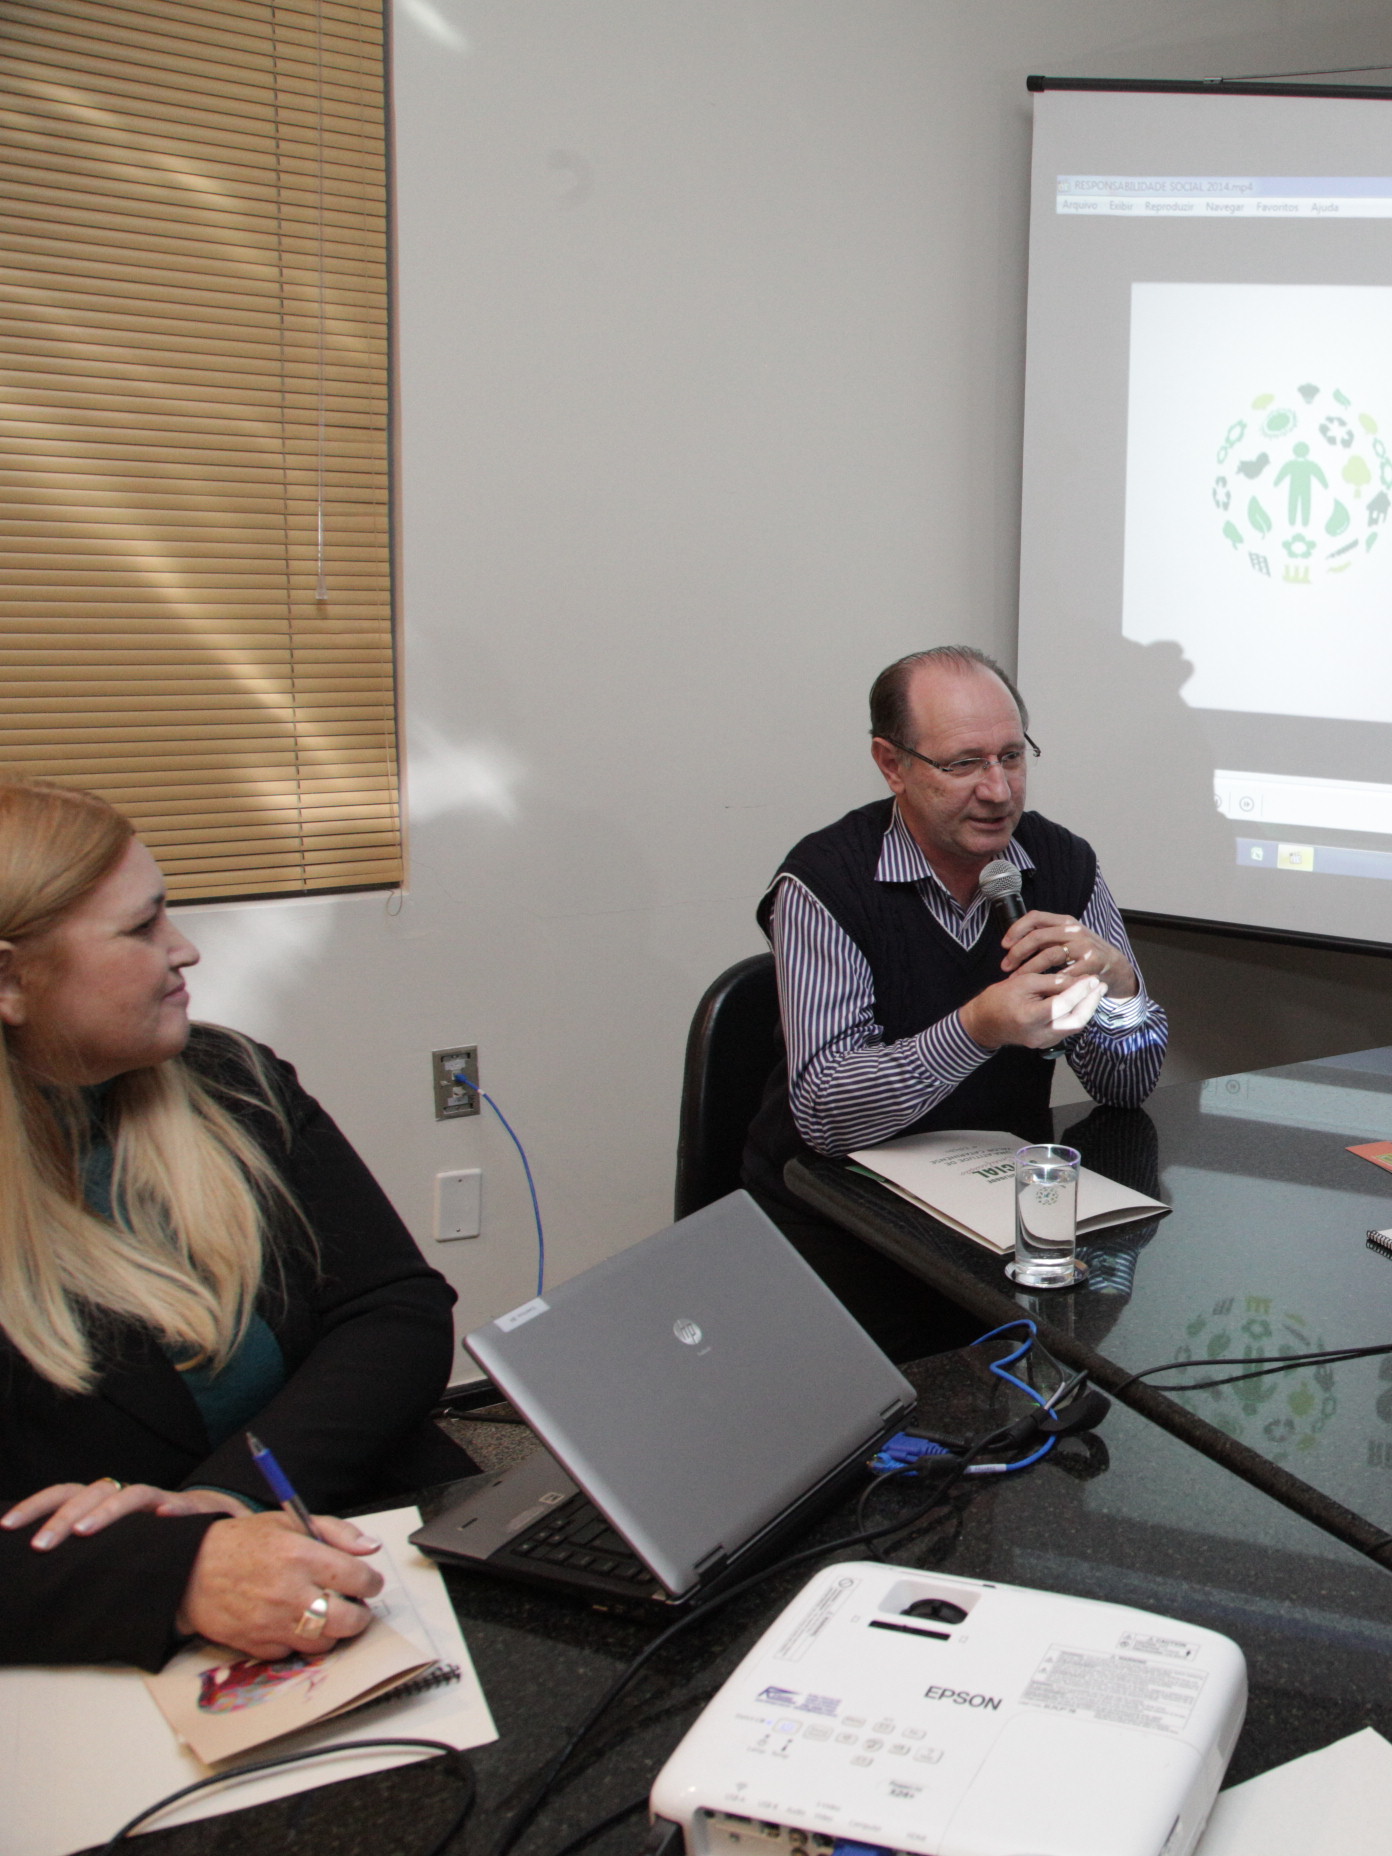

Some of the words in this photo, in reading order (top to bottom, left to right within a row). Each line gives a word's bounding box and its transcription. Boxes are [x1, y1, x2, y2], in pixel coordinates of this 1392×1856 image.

[1074, 181, 1167, 192] RESPONSABILIDADE
[1169, 182, 1203, 192] SOCIAL
[1206, 182, 1253, 194] 2014.mp4
[1062, 200, 1098, 211] Arquivo
[1109, 200, 1133, 210] Exibir
[1145, 201, 1194, 213] Reproduzir
[1206, 202, 1244, 214] Navegar
[1256, 202, 1299, 212] Favoritos
[1311, 202, 1339, 214] Ajuda
[924, 1685, 1003, 1711] EPSON
